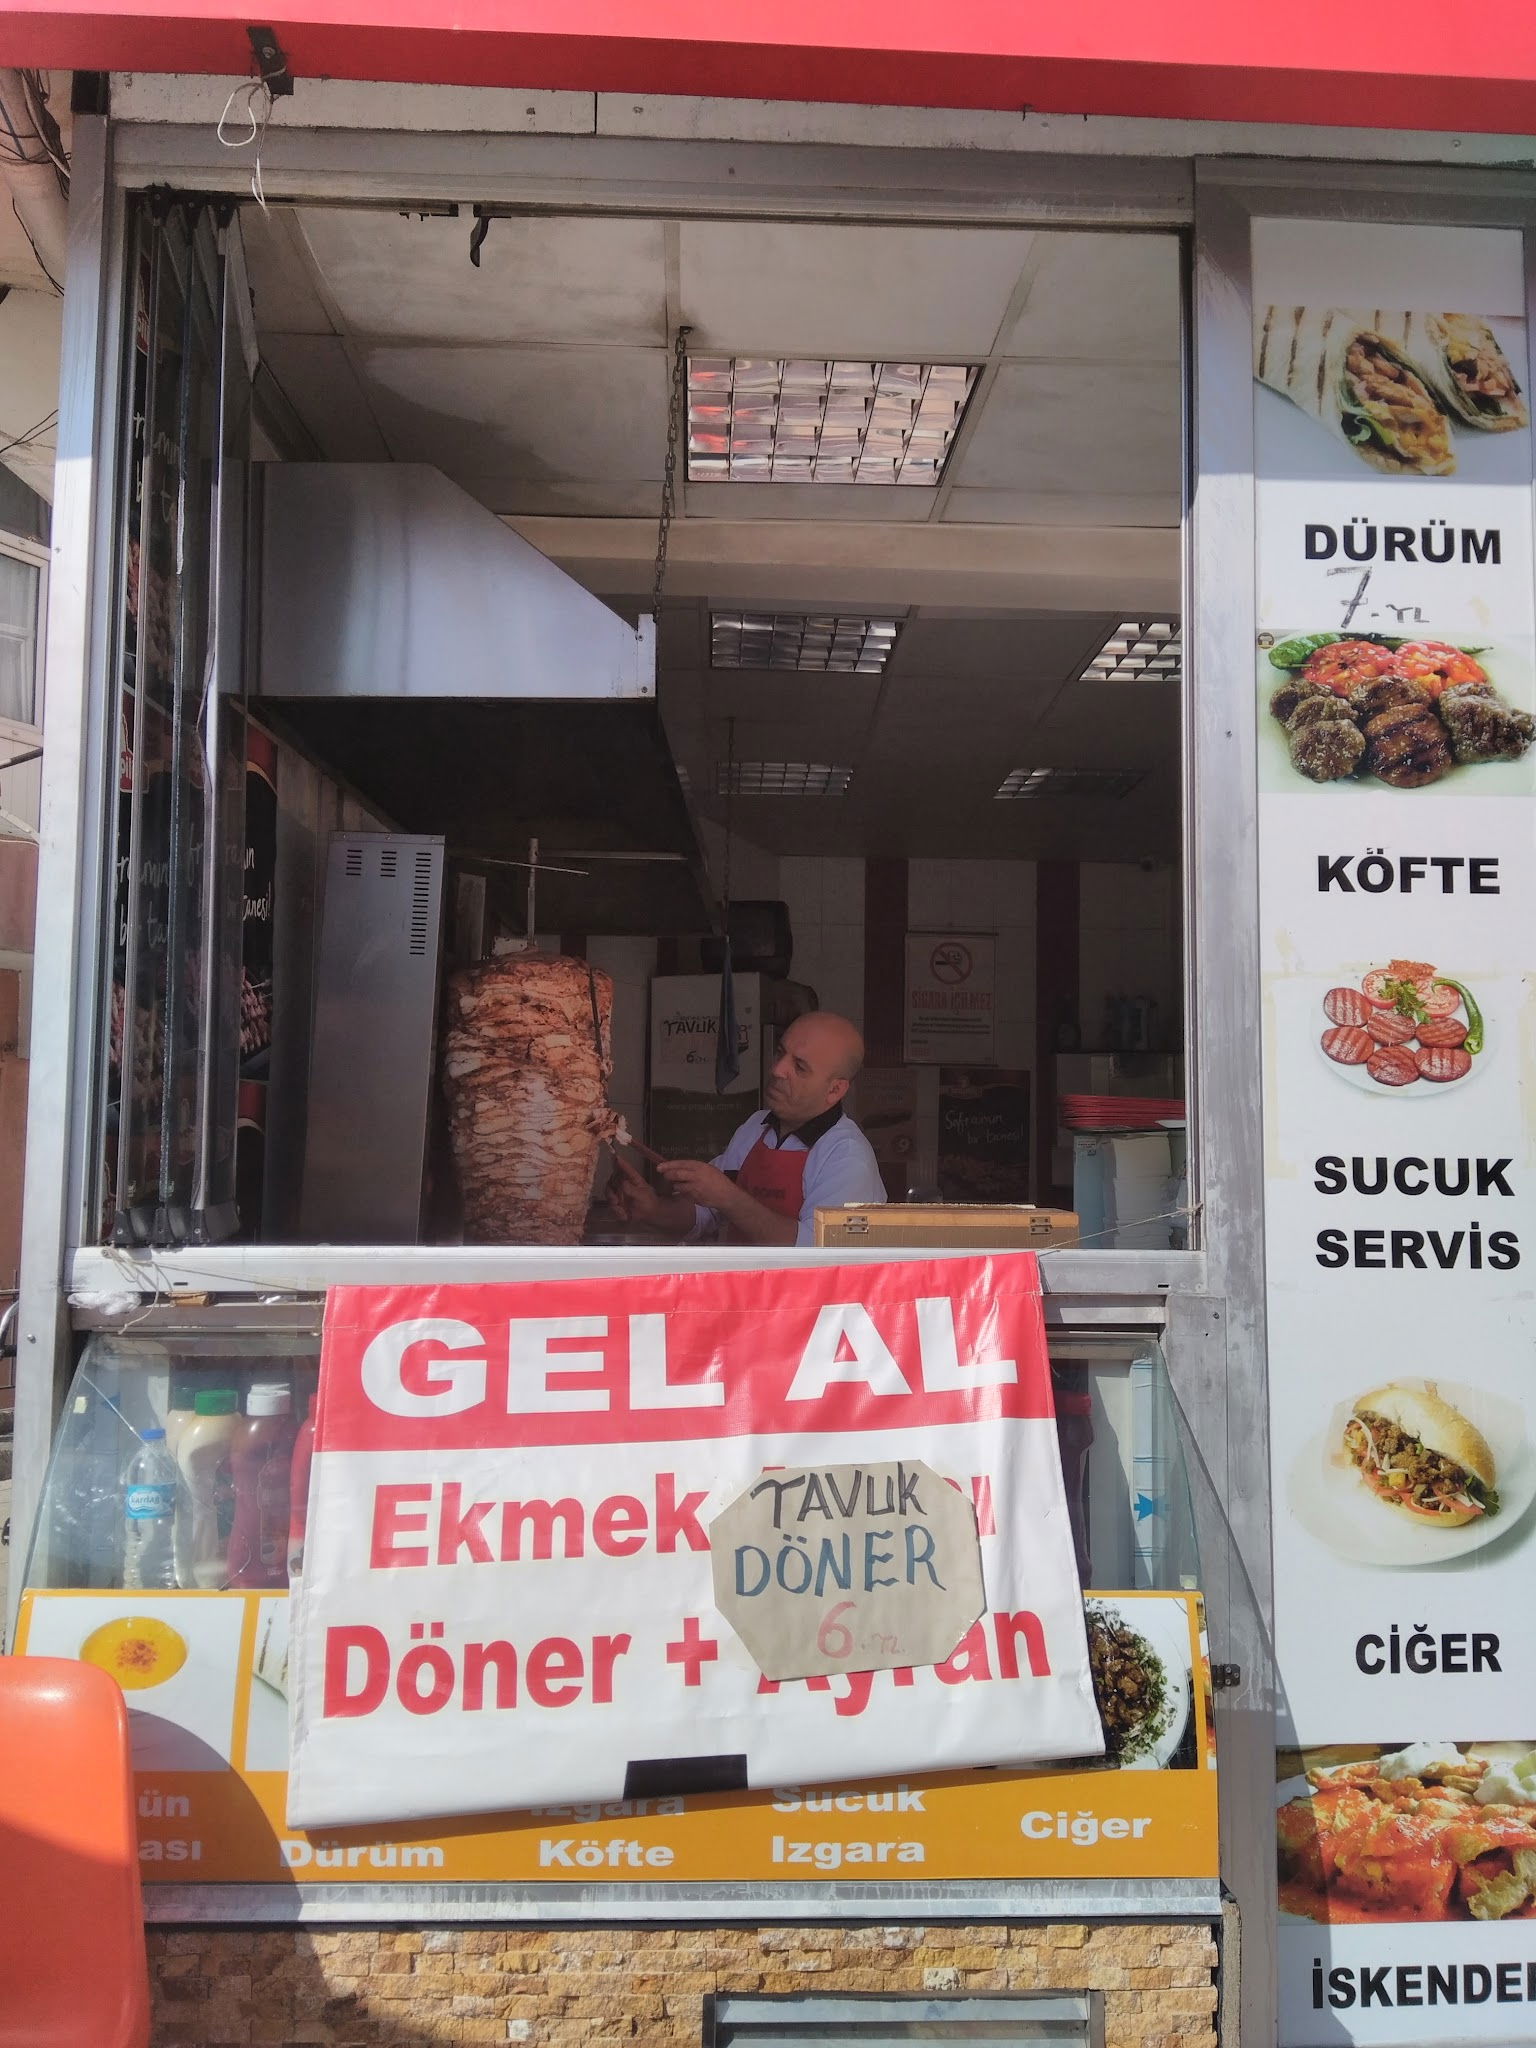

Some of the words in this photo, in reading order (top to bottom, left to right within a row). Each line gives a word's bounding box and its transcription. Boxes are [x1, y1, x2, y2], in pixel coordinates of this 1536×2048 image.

[1304, 517, 1502, 565] DÜRÜM
[1317, 848, 1501, 895] KÖFTE
[663, 1019, 717, 1037] TAVUK
[1314, 1155, 1516, 1197] SUCUK
[1315, 1221, 1521, 1270] SERVİS
[360, 1312, 725, 1418] GEL
[784, 1296, 1019, 1401] AL
[750, 1461, 928, 1529] TAVUK
[369, 1472, 712, 1570] Ekmek
[734, 1523, 947, 1597] DÖNER
[322, 1622, 632, 1719] Döner
[666, 1616, 718, 1687] +
[1355, 1622, 1503, 1675] CİĞER
[771, 1784, 926, 1813] Sucuk
[1020, 1810, 1153, 1846] Ciğer
[279, 1838, 445, 1868] Dürüm
[539, 1838, 675, 1867] Köfte
[771, 1836, 925, 1870] Izgara
[1312, 1957, 1536, 2009] İSKENDE
